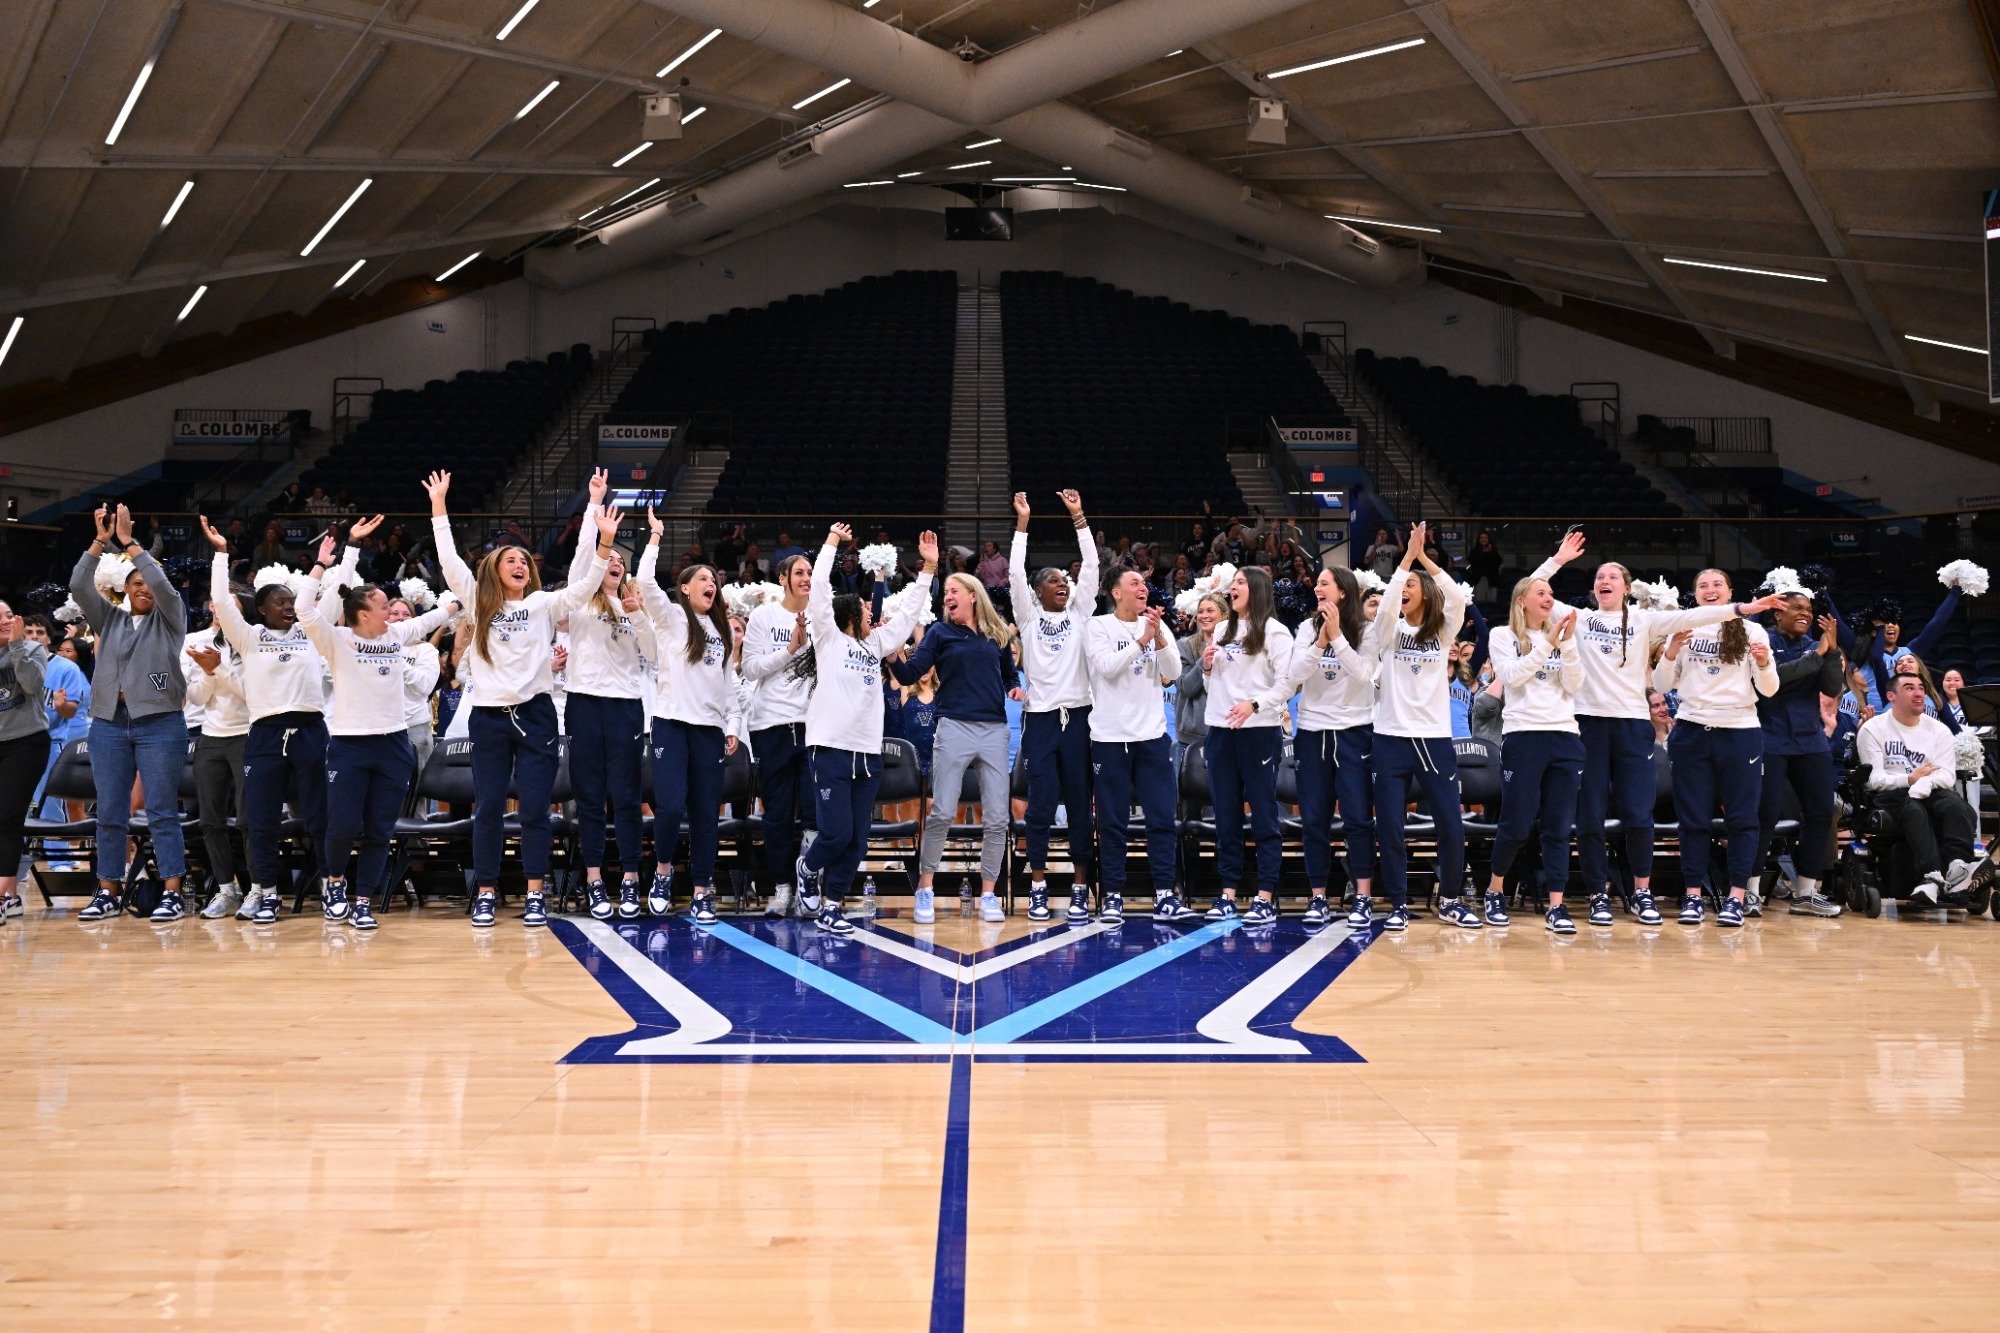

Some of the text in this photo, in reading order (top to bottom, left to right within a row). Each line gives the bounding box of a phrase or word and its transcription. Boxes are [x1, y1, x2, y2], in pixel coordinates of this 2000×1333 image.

[602, 428, 614, 439] La
[1291, 431, 1352, 441] COLOMBE
[286, 529, 302, 537] 101
[1322, 532, 1338, 540] 102
[149, 672, 169, 691] V
